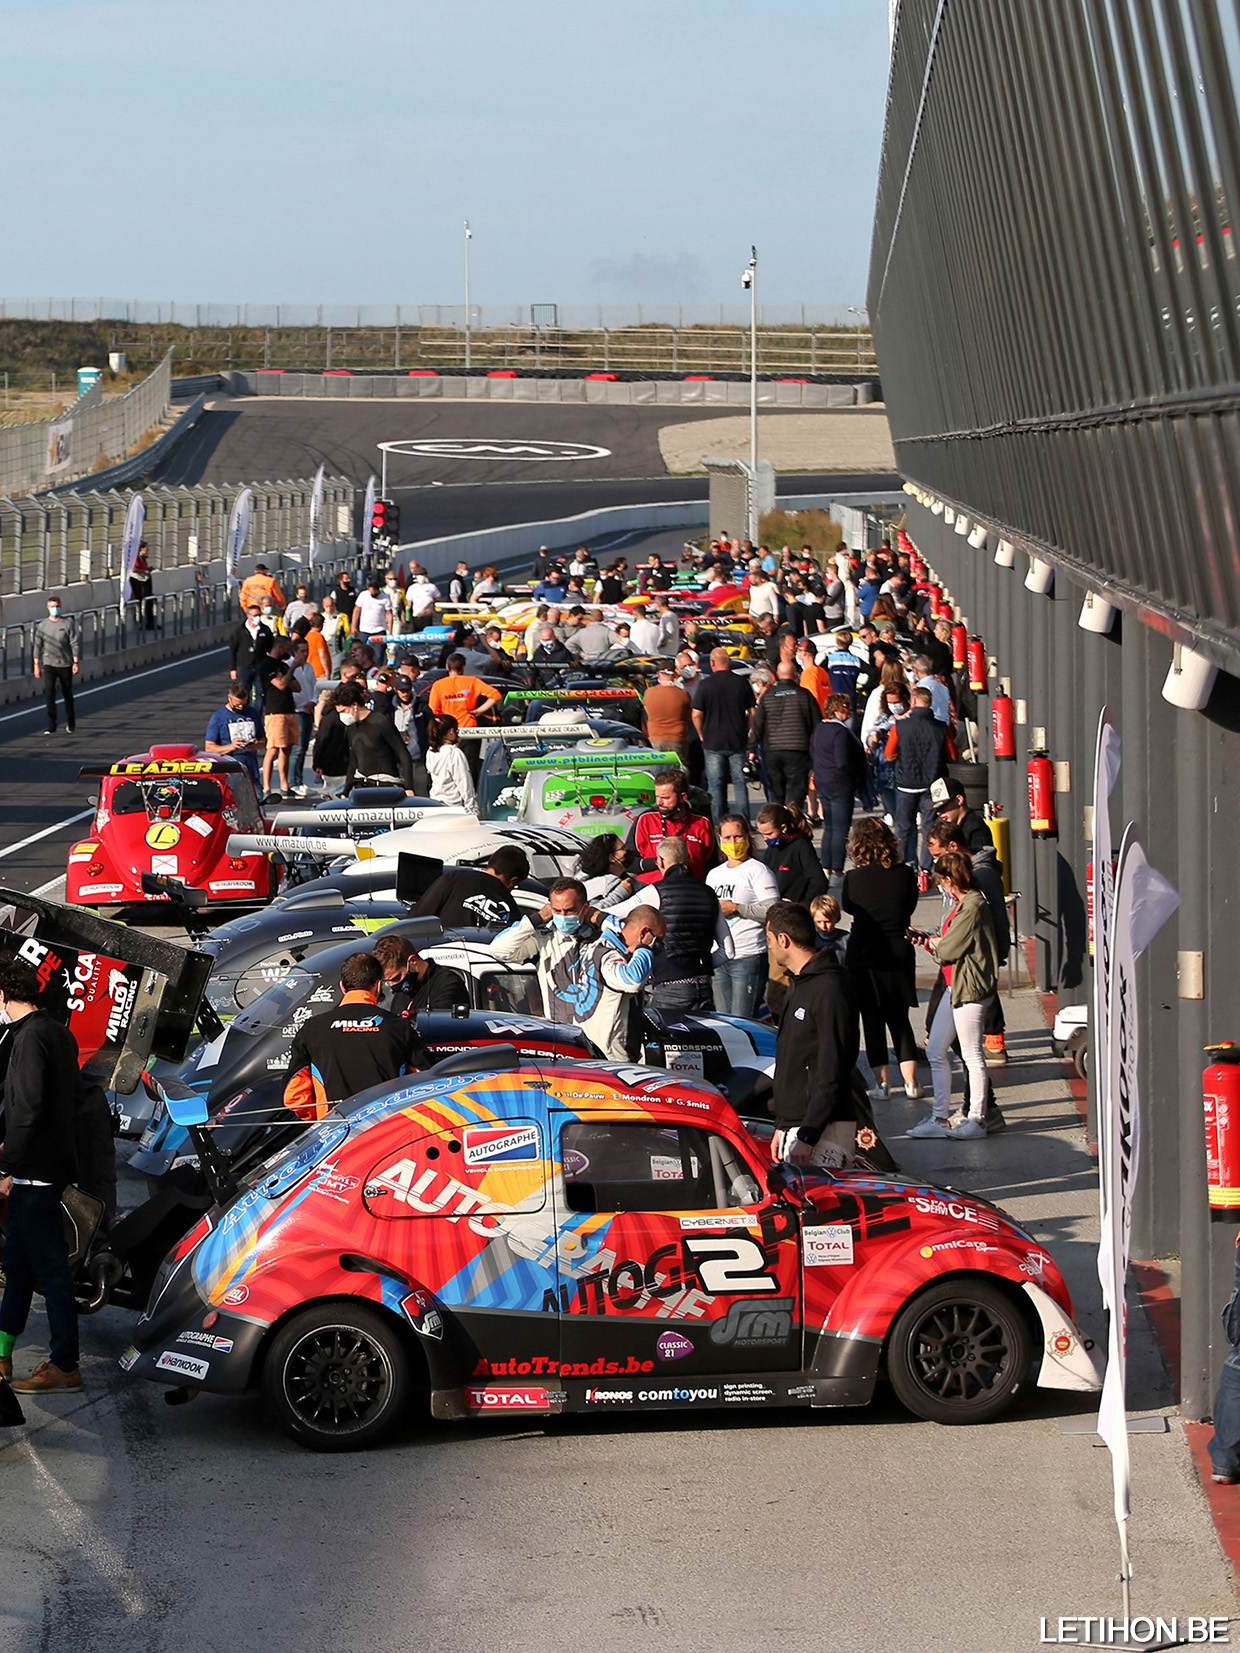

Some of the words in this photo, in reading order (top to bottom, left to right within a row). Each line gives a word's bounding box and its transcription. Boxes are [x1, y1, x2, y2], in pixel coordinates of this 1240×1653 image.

[109, 762, 213, 775] LEADER
[87, 960, 103, 1002] QUALITY
[120, 980, 138, 1029] RACING
[342, 1025, 380, 1033] RACING
[663, 1044, 723, 1052] MOTORSPORT
[670, 1062, 701, 1071] TOTAL
[583, 1092, 605, 1100] Pauw
[621, 1093, 662, 1103] Mondron
[676, 1098, 685, 1106] G.
[686, 1099, 711, 1110] Smits
[468, 1130, 537, 1159] AUTOGRAPHE
[493, 1164, 542, 1172] CONVERSIONS
[681, 1216, 747, 1228] CYBERNET
[804, 1229, 826, 1237] Belgian
[807, 1241, 850, 1250] TOTAL
[684, 1238, 777, 1291] 2
[659, 1340, 689, 1350] CLASSIC
[733, 1337, 788, 1346] MOTORSPORT
[664, 1349, 675, 1358] 21
[473, 1356, 655, 1377] AutoTrends.be
[737, 1383, 763, 1391] printing
[471, 1390, 538, 1405] TOTAL
[585, 1387, 634, 1401] KRONOS
[638, 1387, 718, 1404] comtoyou
[723, 1389, 751, 1397] dynamic
